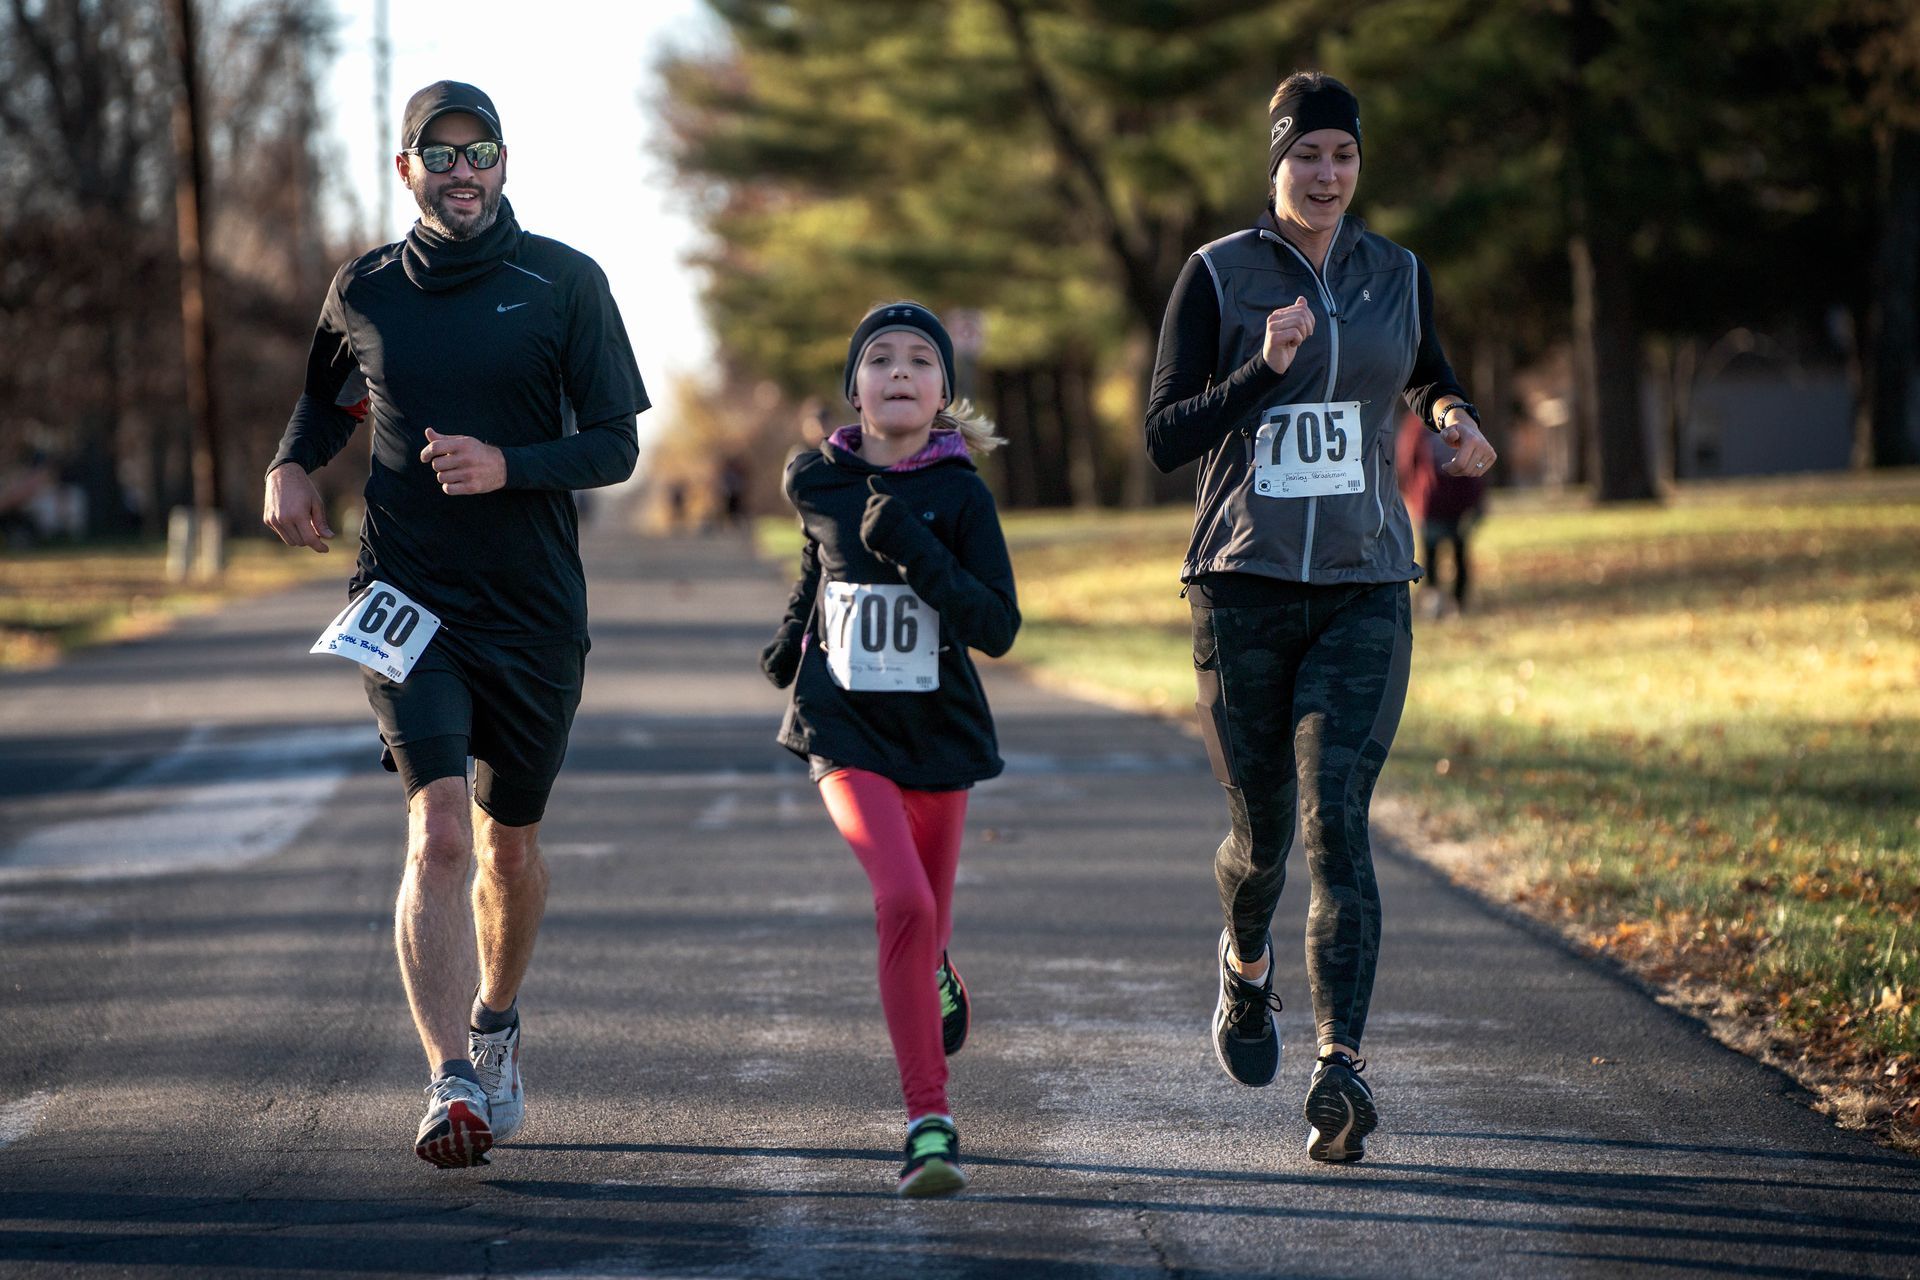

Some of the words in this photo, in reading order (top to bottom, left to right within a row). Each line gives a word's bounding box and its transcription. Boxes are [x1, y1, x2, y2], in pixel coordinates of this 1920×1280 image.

[1270, 411, 1347, 465] 705
[360, 640, 390, 660] Bishop
[839, 594, 919, 654] 706
